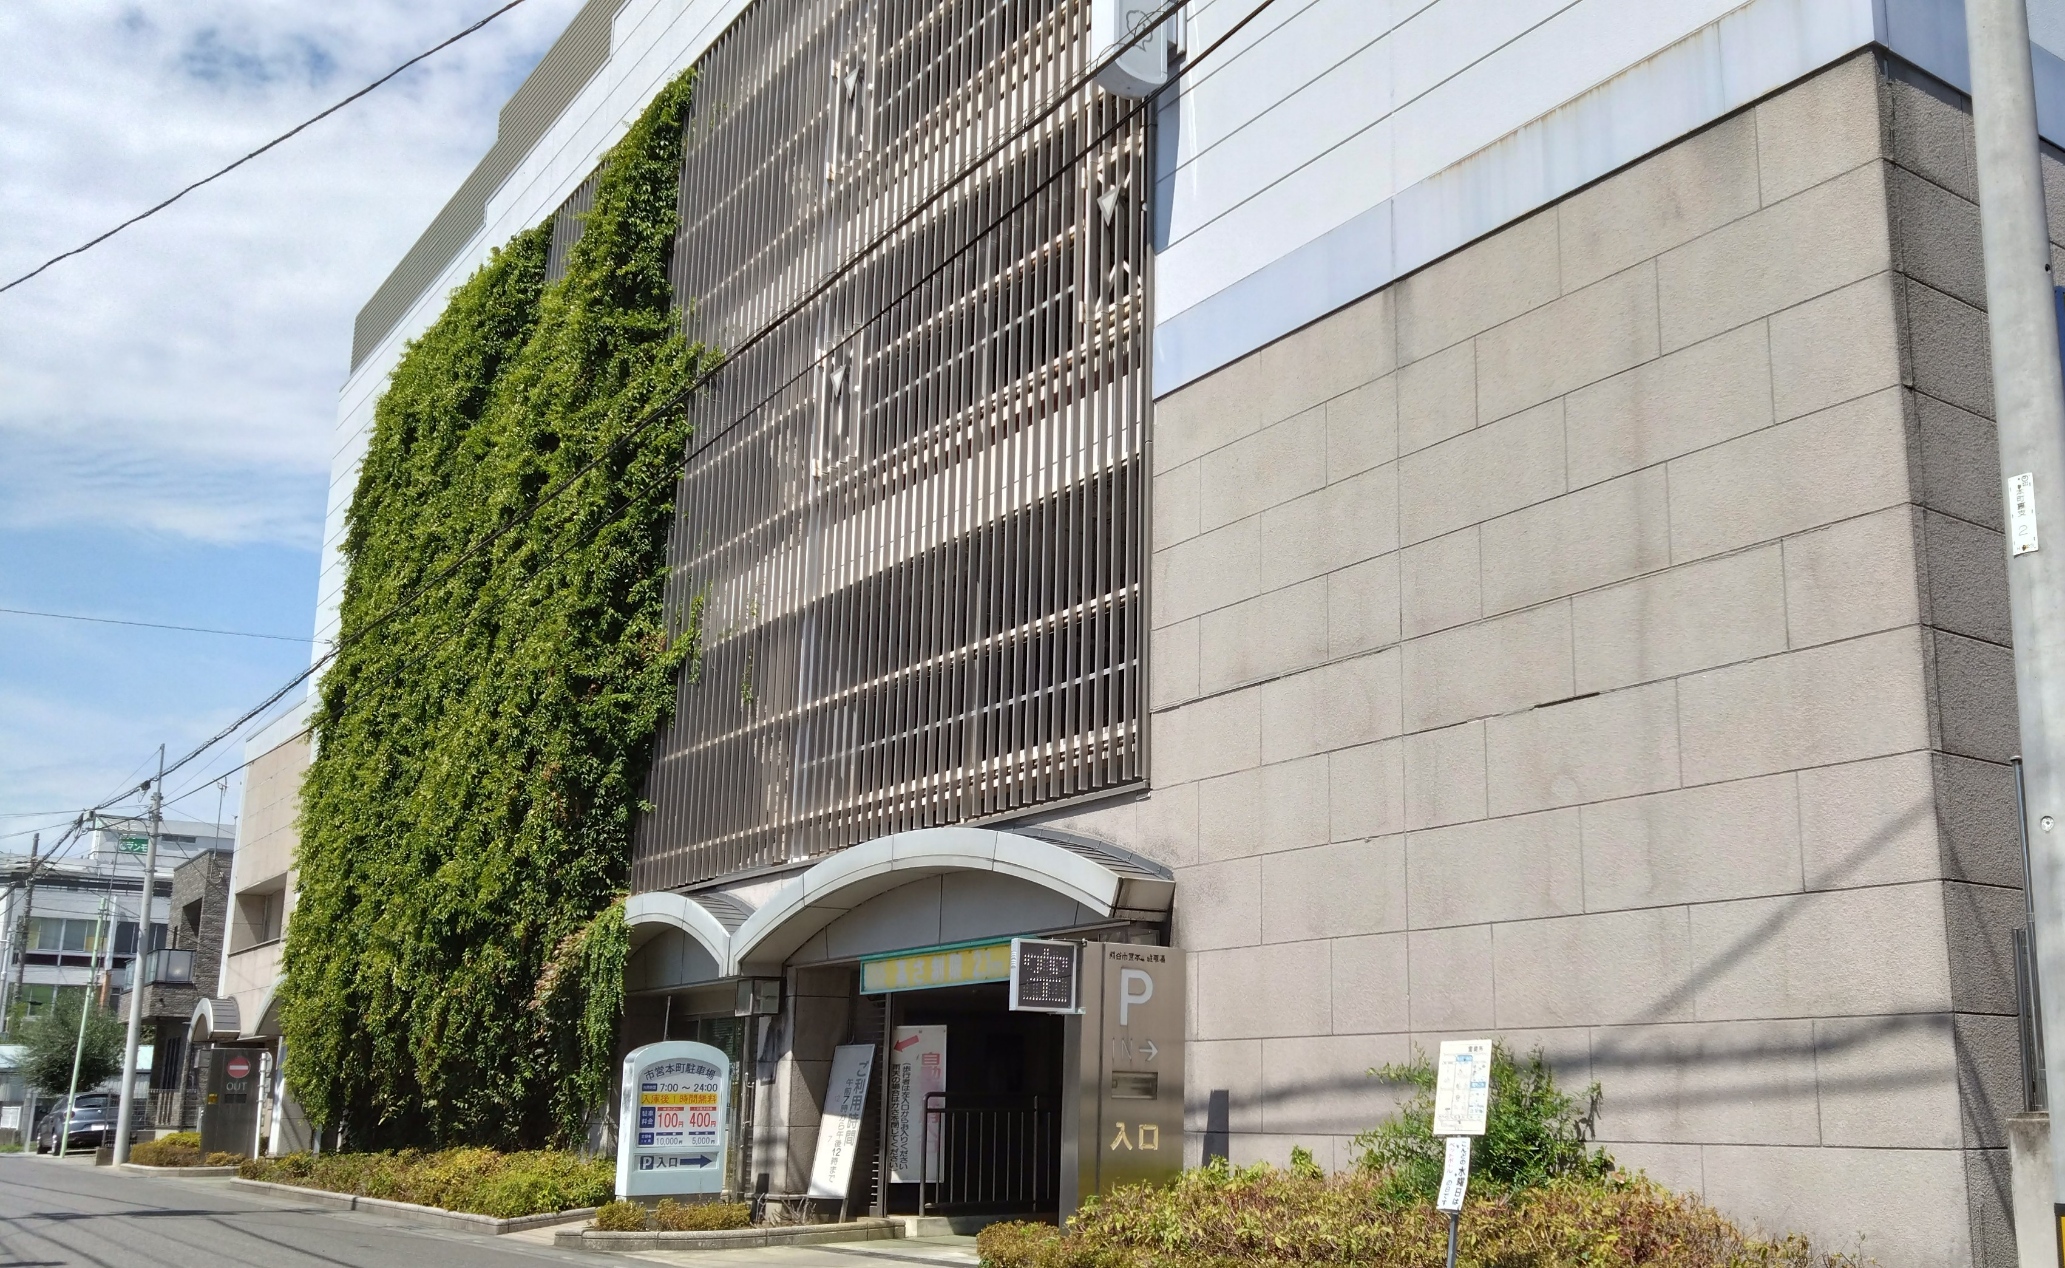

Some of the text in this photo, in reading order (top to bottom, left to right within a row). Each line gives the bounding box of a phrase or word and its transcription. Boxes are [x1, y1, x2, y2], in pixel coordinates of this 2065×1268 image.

[1022, 948, 1069, 1003] 空
[1120, 967, 1154, 1026] P
[1112, 1037, 1133, 1063] IN
[644, 1063, 716, 1080] 市営本町駐車場
[226, 1081, 248, 1091] OUT
[660, 1083, 679, 1092] 7:00
[693, 1083, 718, 1092] 24:00
[844, 1060, 869, 1146] ご利用時間
[658, 1112, 684, 1128] 100円
[689, 1112, 717, 1128] 400円
[1109, 1122, 1159, 1151] 入口
[642, 1156, 652, 1169] P
[656, 1157, 678, 1168] 入口
